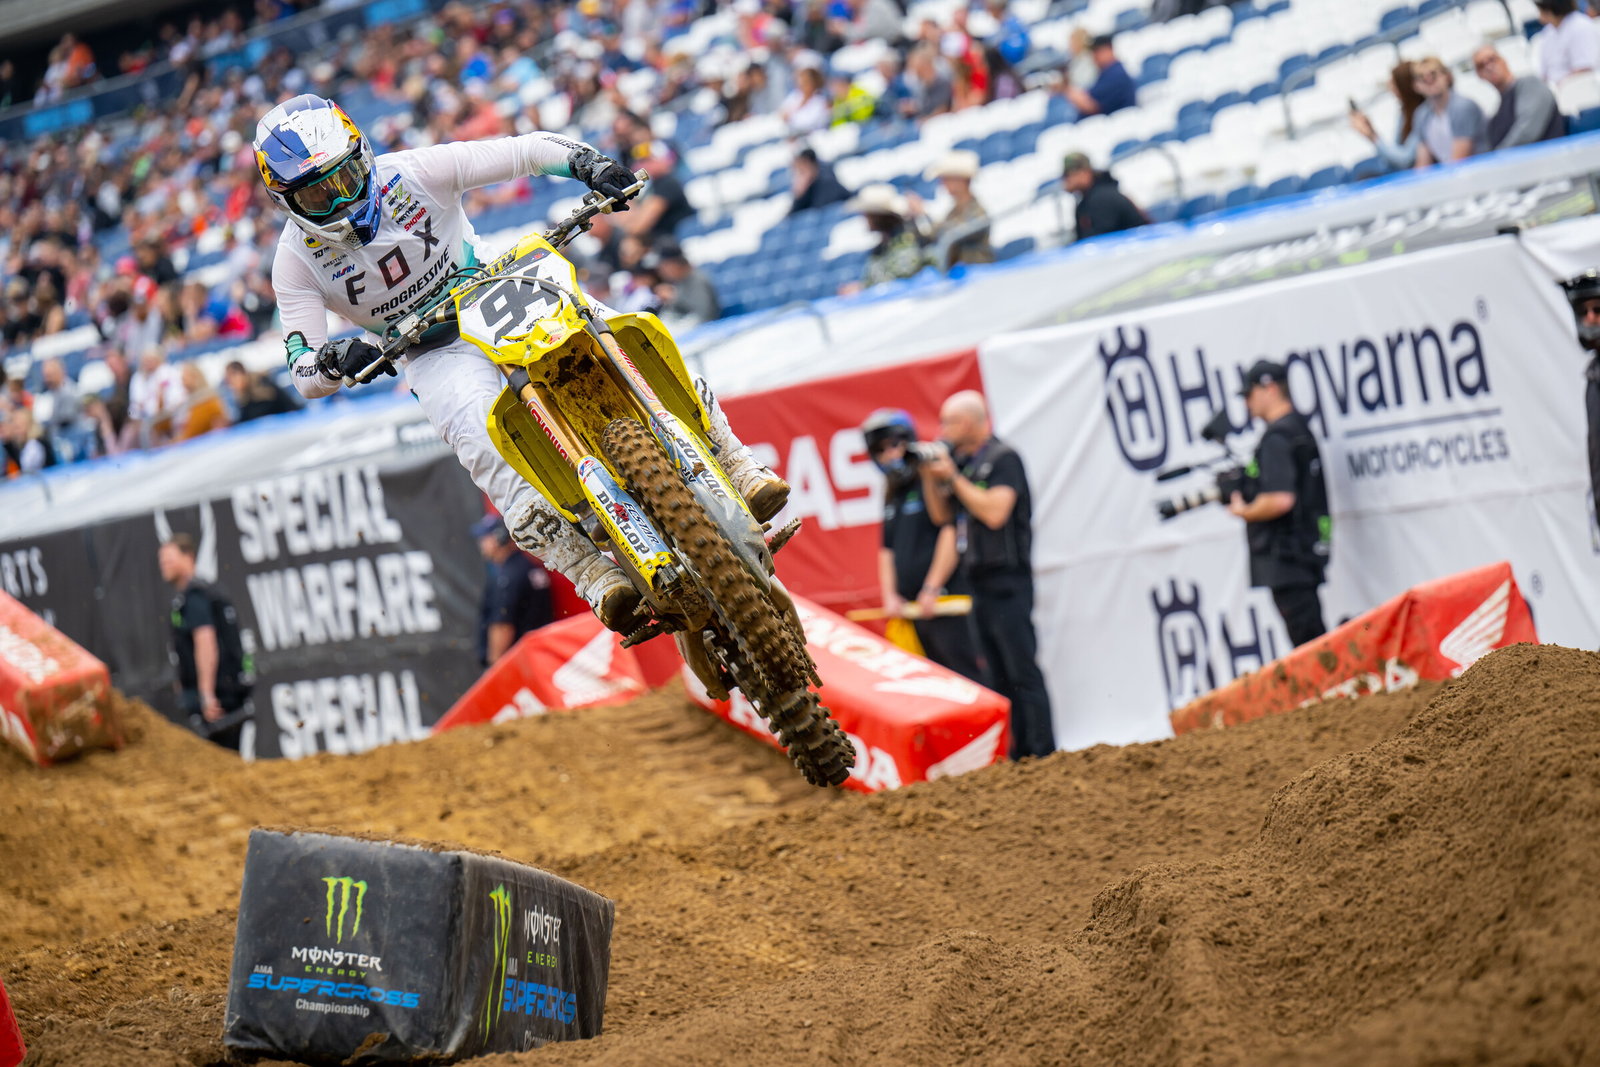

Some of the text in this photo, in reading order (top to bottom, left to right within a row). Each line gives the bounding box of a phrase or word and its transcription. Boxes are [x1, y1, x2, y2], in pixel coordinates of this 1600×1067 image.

[403, 206, 427, 232] SHOWA
[345, 215, 440, 306] FOX
[370, 247, 450, 317] PROGRESSIVE
[480, 264, 560, 346] 94
[1169, 318, 1491, 443] Huqvarna
[1346, 427, 1510, 481] MOTORCYCLES
[231, 463, 403, 564] SPECIAL
[596, 490, 650, 555] DUNLOP
[247, 550, 442, 651] WARFARE
[271, 669, 434, 762] SPECIAL
[524, 904, 562, 946] MONSTER
[253, 964, 274, 975] AMA
[291, 946, 383, 972] MONSTER
[305, 965, 368, 979] ENERGY
[246, 973, 421, 1008] SUPERCROSS
[295, 998, 370, 1018] Championship
